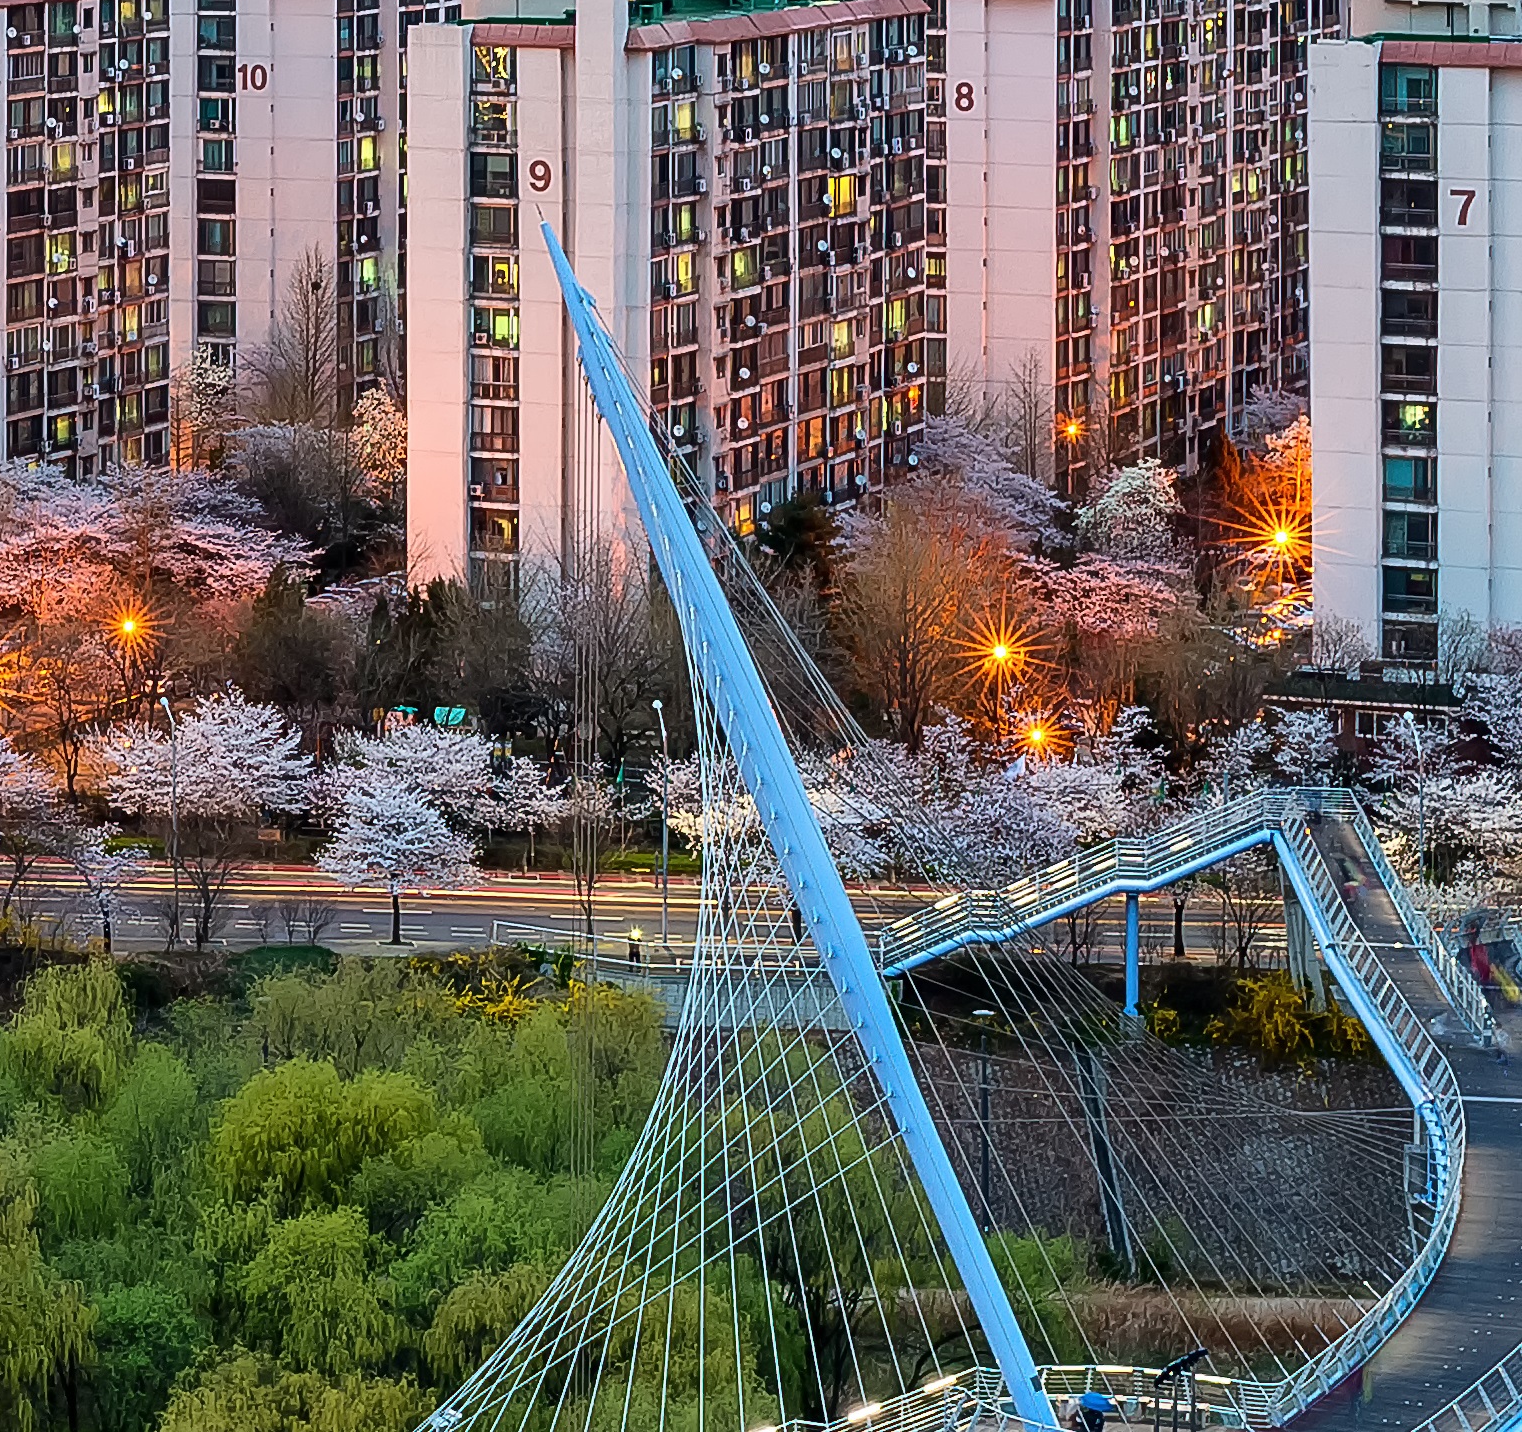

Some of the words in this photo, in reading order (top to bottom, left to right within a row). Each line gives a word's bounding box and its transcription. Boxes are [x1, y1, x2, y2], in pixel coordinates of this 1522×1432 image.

[237, 63, 268, 91] 10
[955, 81, 974, 112] 8
[529, 159, 551, 192] 9
[1450, 189, 1476, 226] 7
